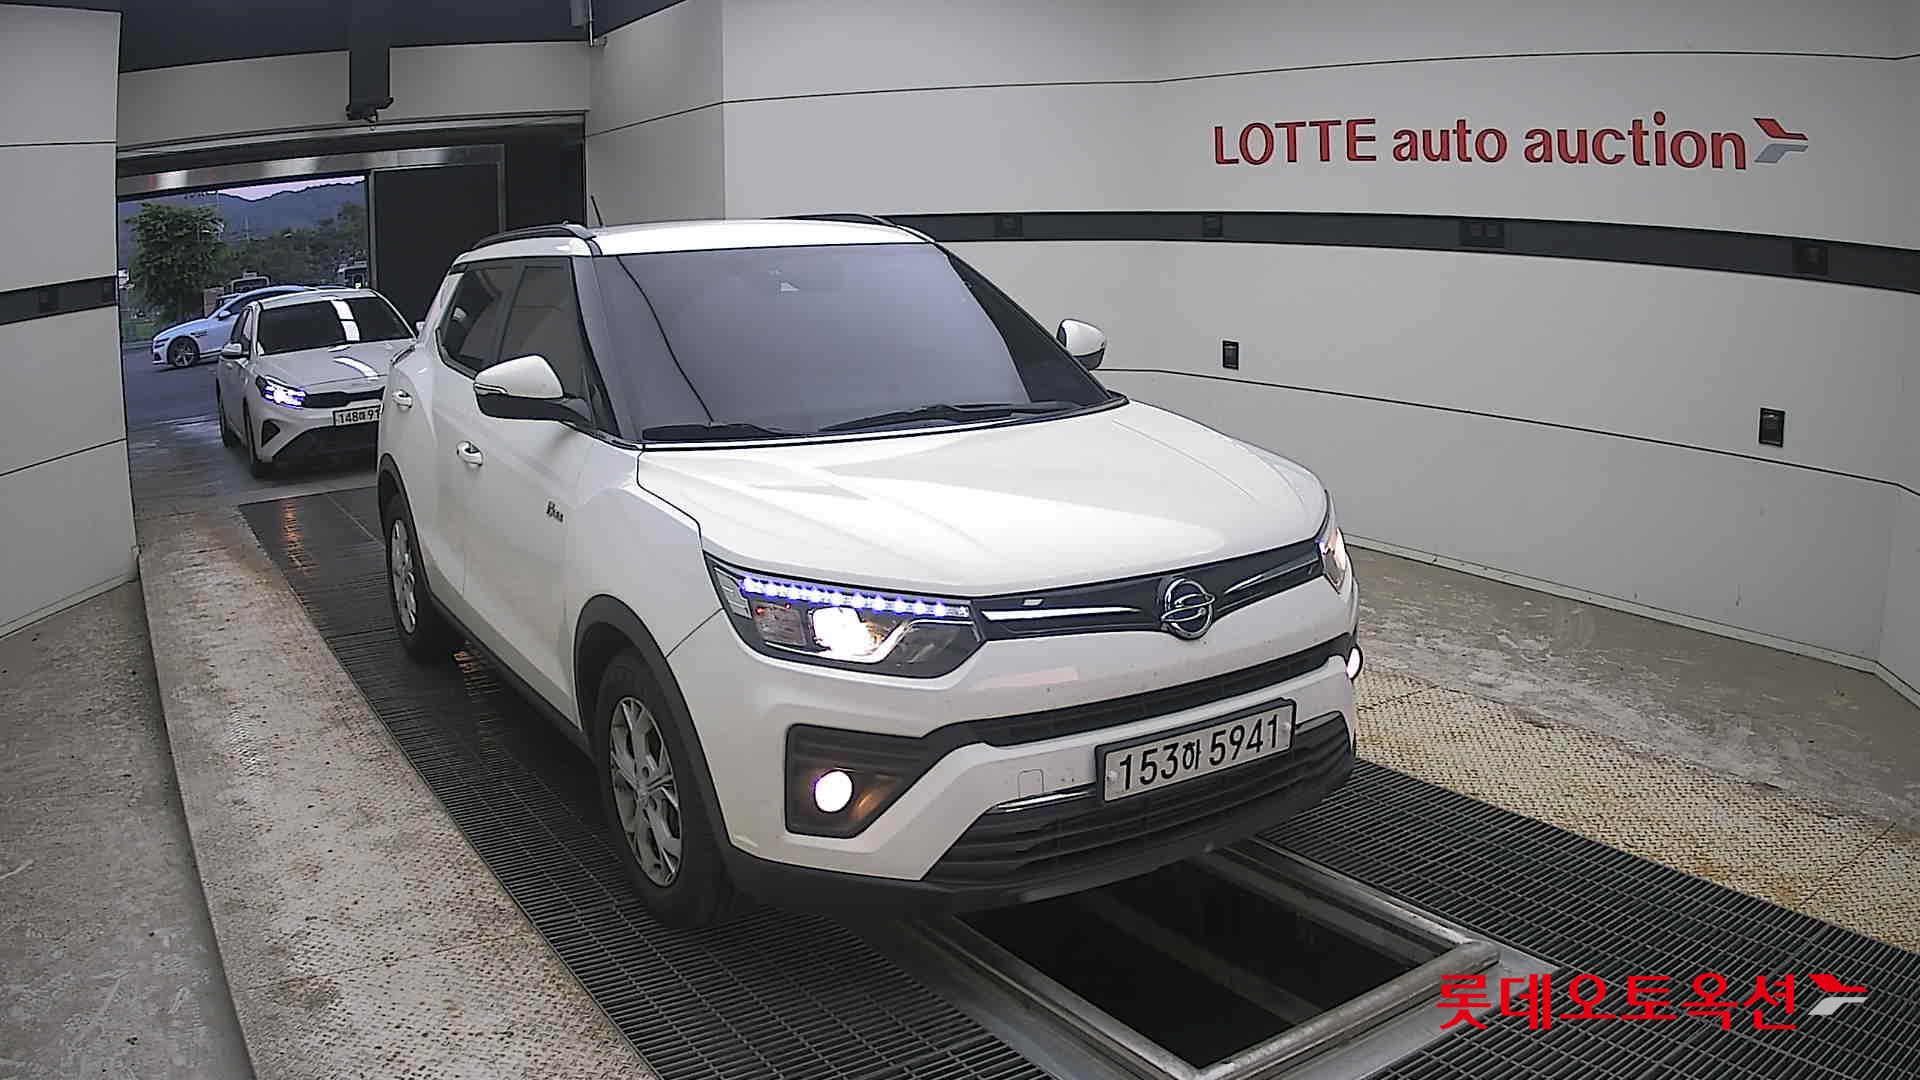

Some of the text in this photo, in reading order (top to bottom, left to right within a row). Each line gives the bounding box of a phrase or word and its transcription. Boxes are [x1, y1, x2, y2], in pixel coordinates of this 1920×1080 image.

[1214, 112, 1747, 170] LOTTE auto auction
[1118, 713, 1279, 791] 153하 5941
